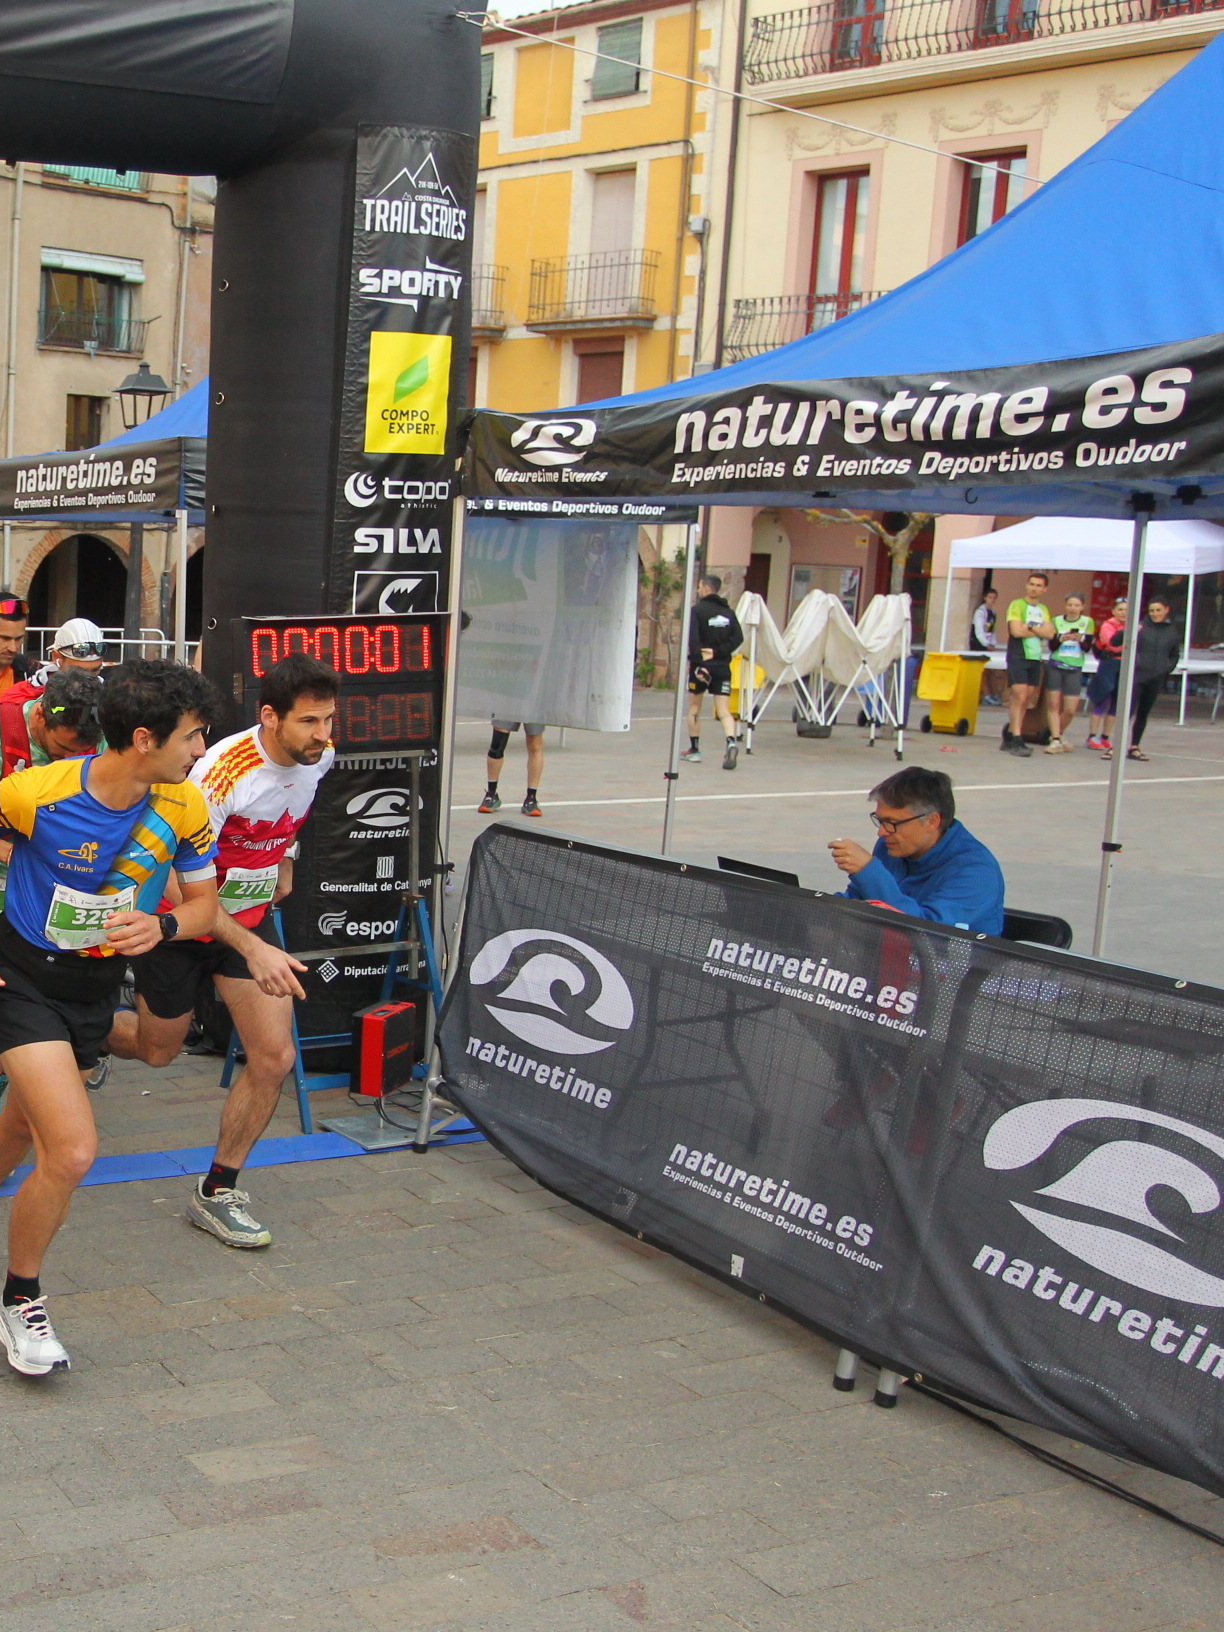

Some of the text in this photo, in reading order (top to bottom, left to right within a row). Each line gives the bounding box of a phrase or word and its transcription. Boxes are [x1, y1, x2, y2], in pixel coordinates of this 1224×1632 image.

[414, 194, 433, 202] COSTA
[362, 198, 467, 242] TRAILSERIES
[358, 267, 463, 300] SPORTY
[380, 408, 430, 422] COMPO
[673, 367, 1193, 454] naturetime.es
[388, 422, 436, 436] EXPERT
[15, 453, 158, 494] naturetime.es
[494, 466, 609, 484] Naturetime Events
[670, 438, 1187, 488] Experiencias & Eventos Deportivos Oudoor
[13, 489, 157, 512] Experiencias & Eventos Deportivos Oudoor
[381, 476, 450, 504] topo
[484, 498, 494, 511] &
[497, 499, 549, 513] Eventos
[551, 500, 619, 517] Deportivos
[621, 502, 666, 516] Oudoor
[353, 527, 443, 554] SILVA
[234, 880, 266, 896] 277
[320, 881, 378, 893] Generalitat
[380, 881, 393, 892] de
[705, 937, 918, 1015] naturetime.es
[701, 961, 928, 1039] Experiencias & Eventos Deportivos Outdoor
[464, 1035, 613, 1110] naturetime
[668, 1142, 874, 1248] naturetime.es
[661, 1164, 884, 1273] Experiencias & Eventos Deportivos Outdoor
